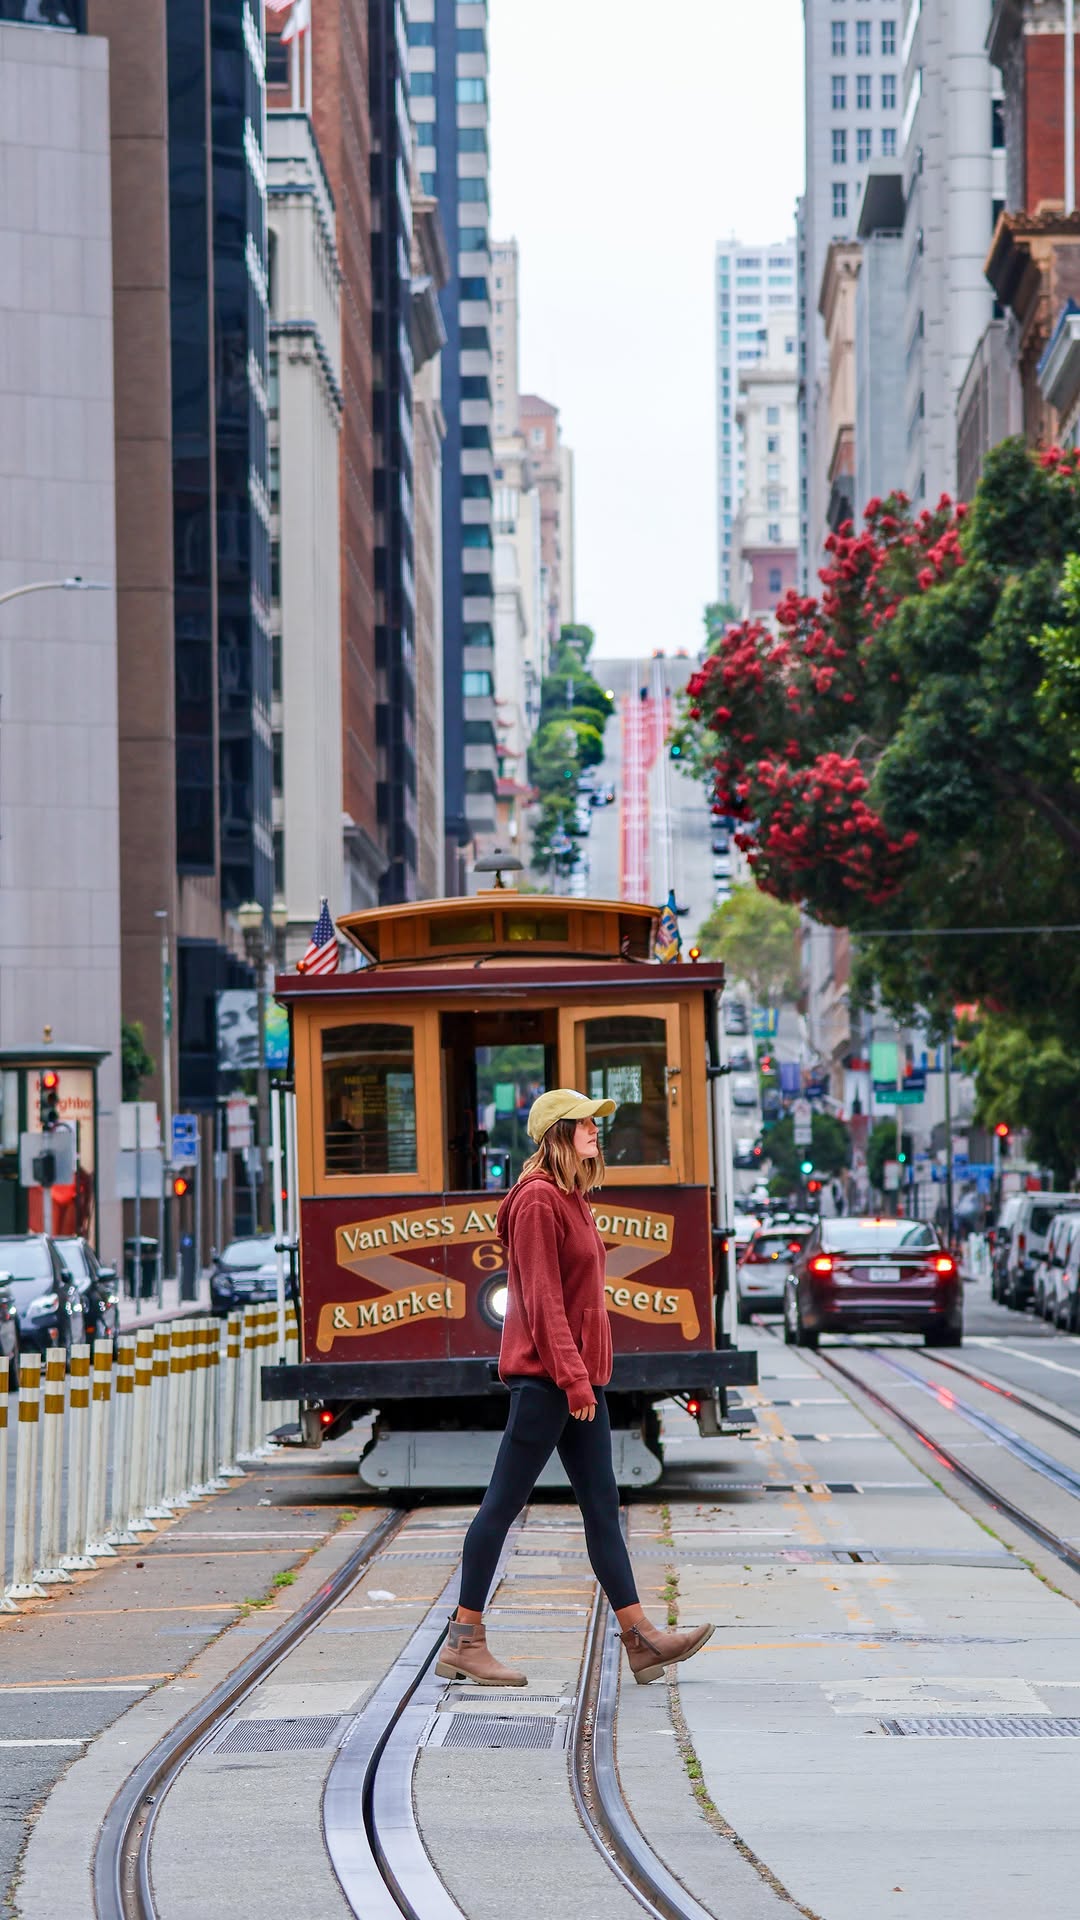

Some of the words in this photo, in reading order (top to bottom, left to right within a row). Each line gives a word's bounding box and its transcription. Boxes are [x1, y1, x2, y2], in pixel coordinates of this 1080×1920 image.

[342, 1228, 389, 1252] Van
[391, 1217, 455, 1243] Ness
[461, 1210, 497, 1234] Av
[472, 1243, 509, 1271] 6
[332, 1305, 353, 1329] &
[357, 1287, 454, 1328] Market
